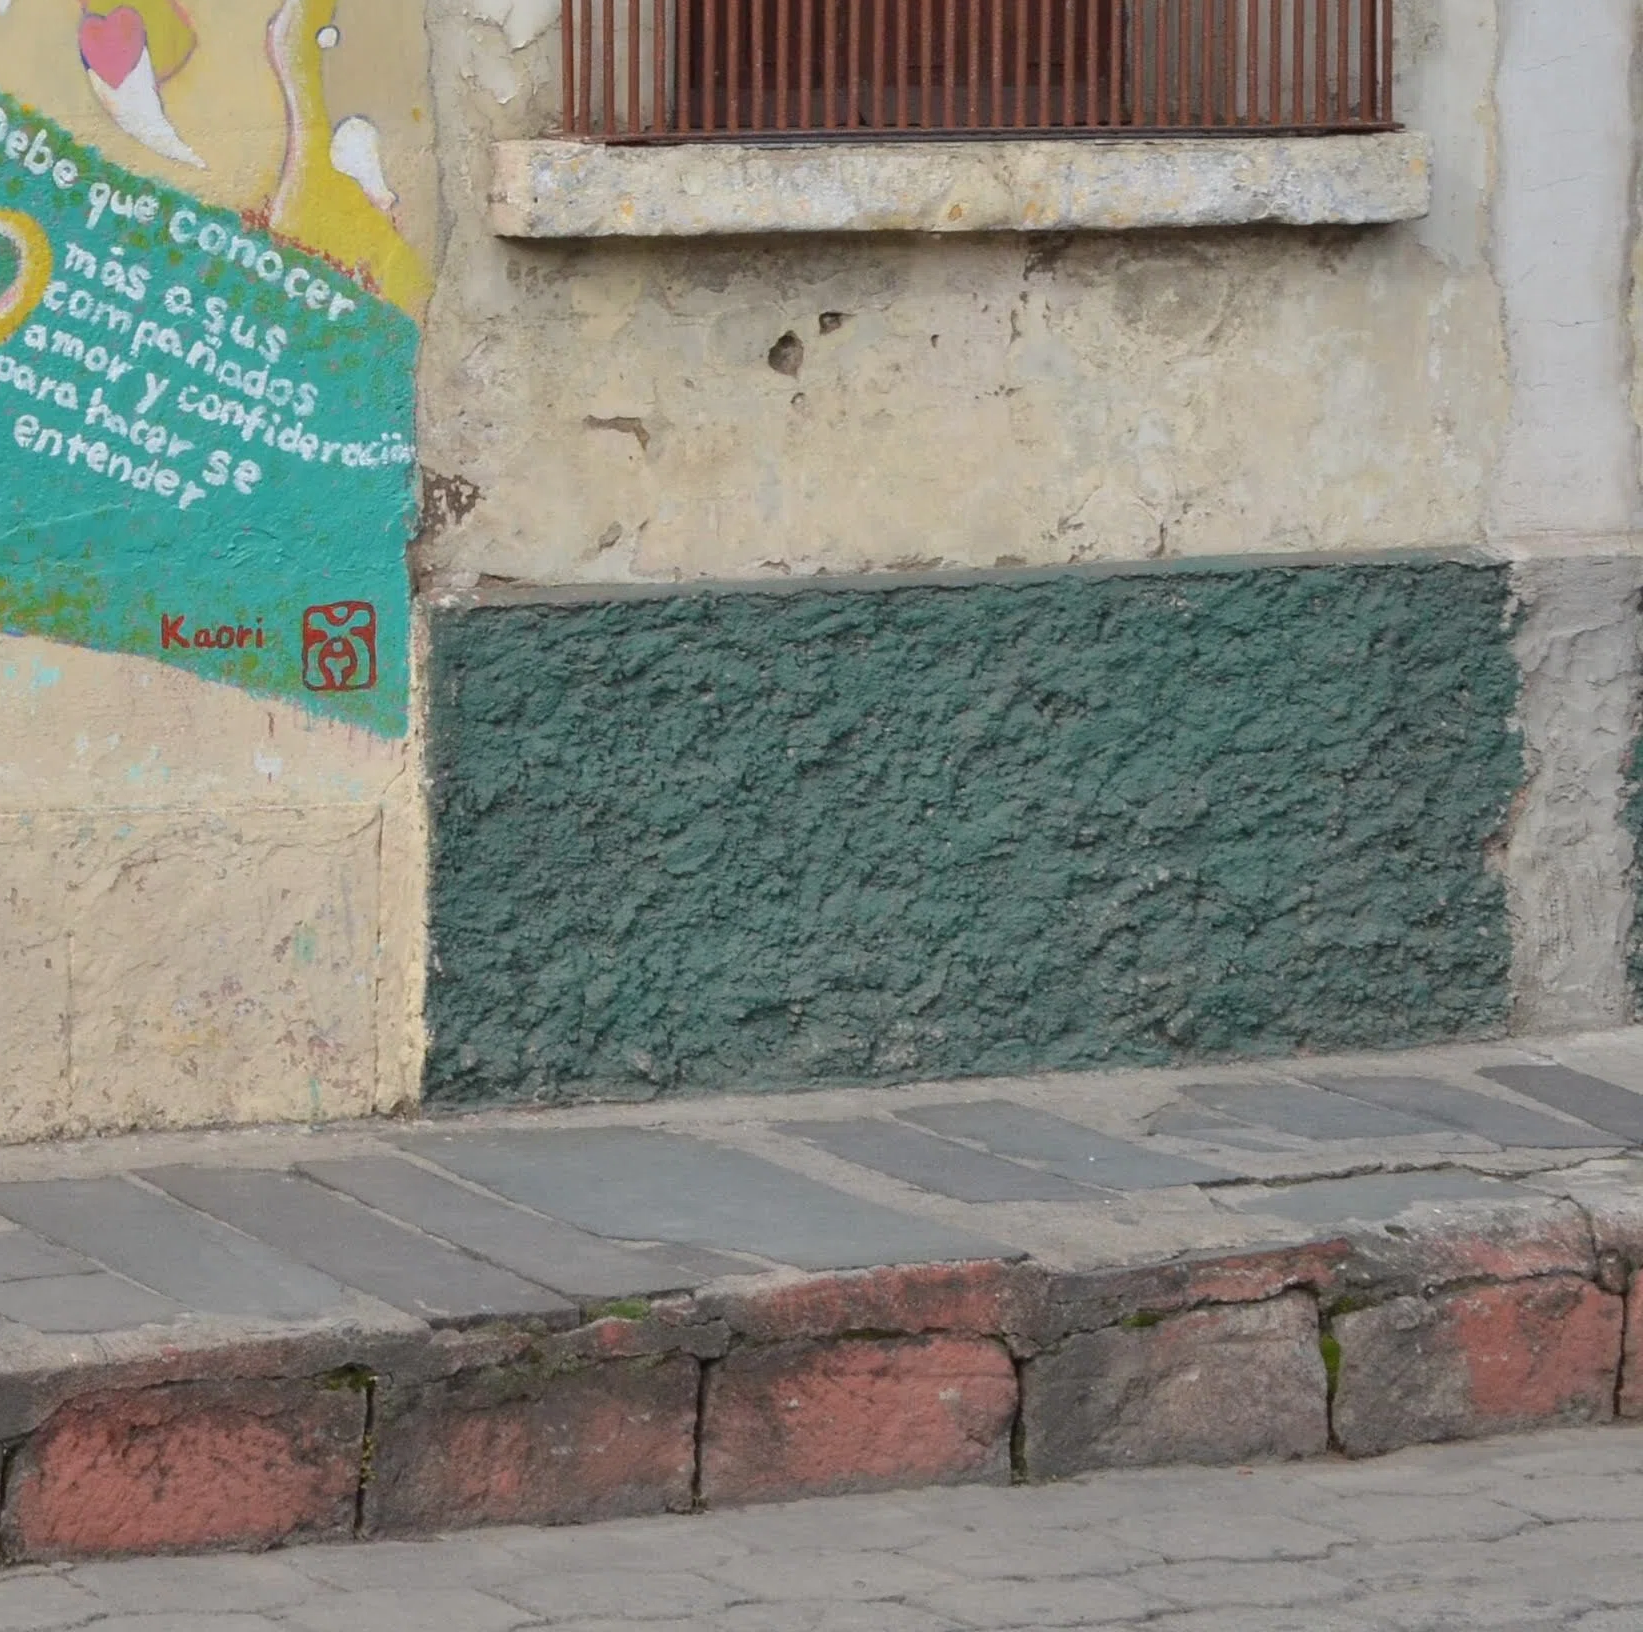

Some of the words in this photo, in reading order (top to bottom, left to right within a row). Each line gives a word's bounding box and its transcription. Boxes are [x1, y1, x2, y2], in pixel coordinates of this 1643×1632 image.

[85, 182, 158, 229] que
[169, 210, 355, 320] conocer
[23, 323, 132, 382] amor
[134, 373, 169, 414] y
[202, 296, 288, 364] sus
[13, 413, 206, 511] entender
[85, 387, 194, 458] hacer
[202, 449, 262, 495] se
[161, 613, 264, 649] Kaori
